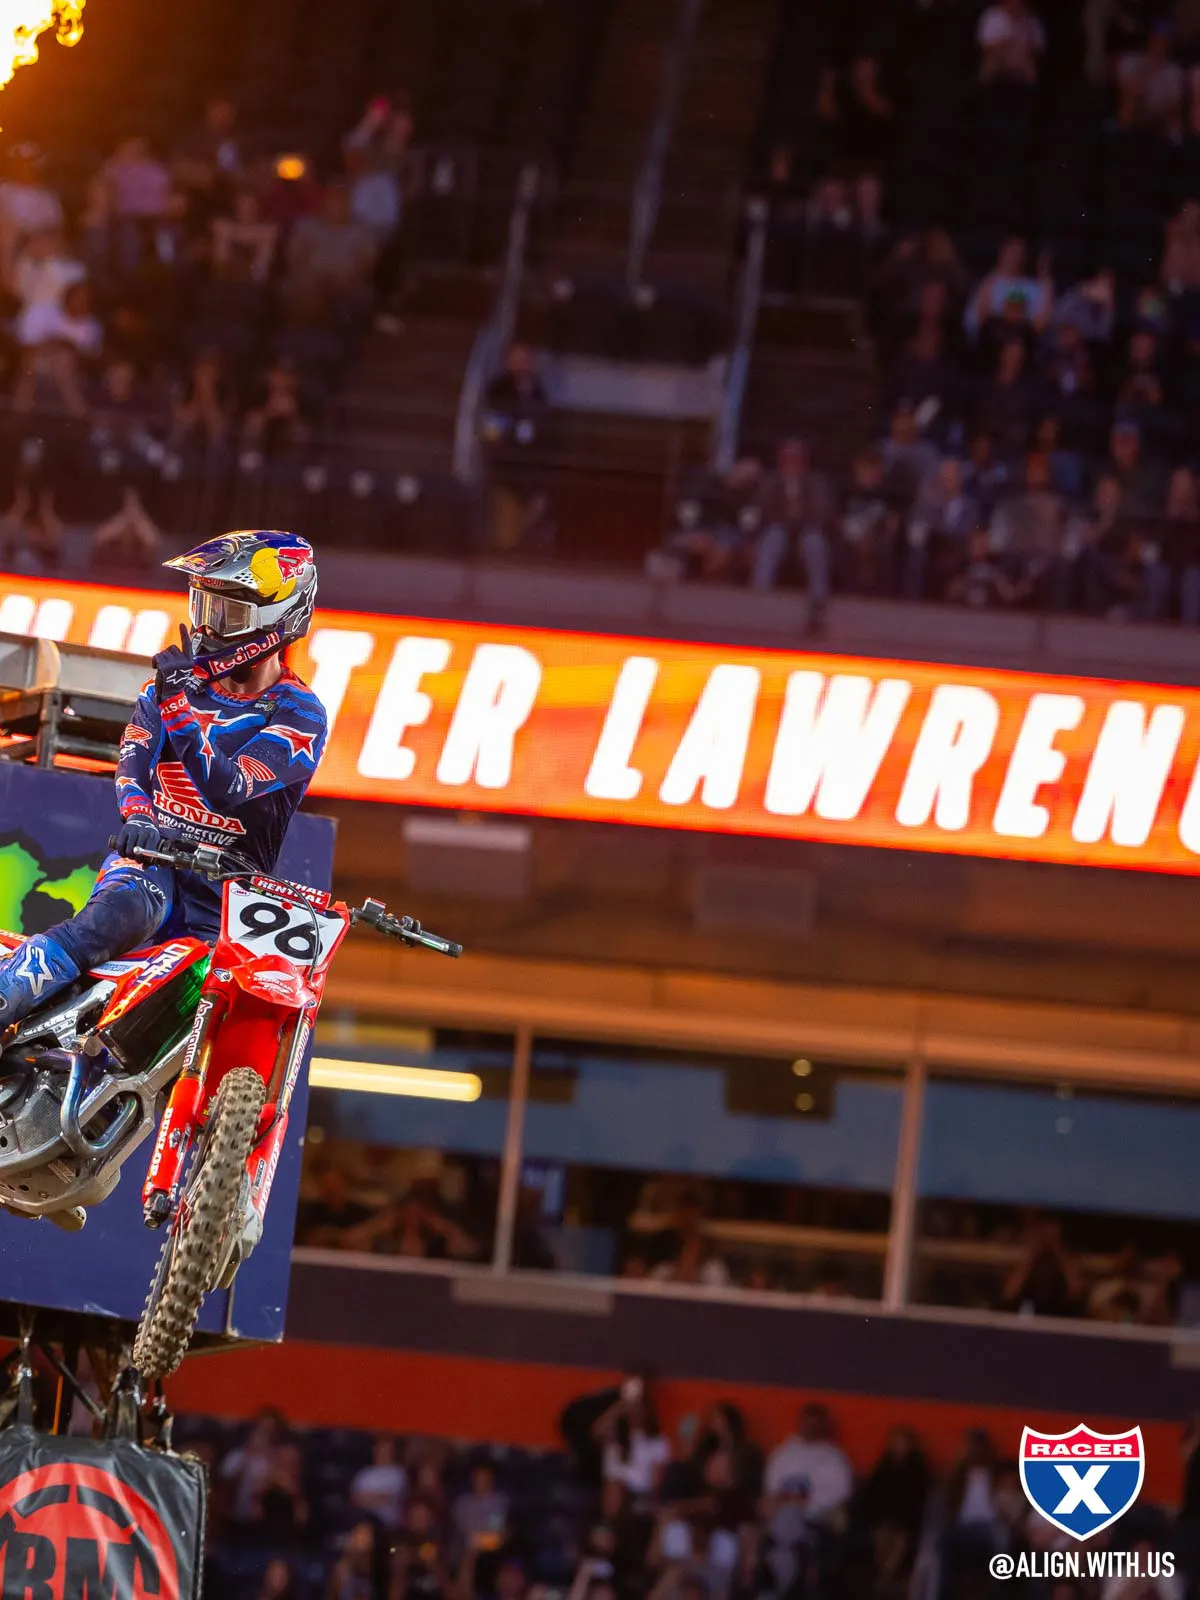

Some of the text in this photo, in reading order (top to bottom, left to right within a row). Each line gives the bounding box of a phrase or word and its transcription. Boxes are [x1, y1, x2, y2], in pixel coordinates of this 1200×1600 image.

[208, 631, 280, 676] Red Bull
[153, 789, 247, 835] HONDA
[239, 901, 329, 960] 96
[150, 1107, 174, 1177] DUNLOP
